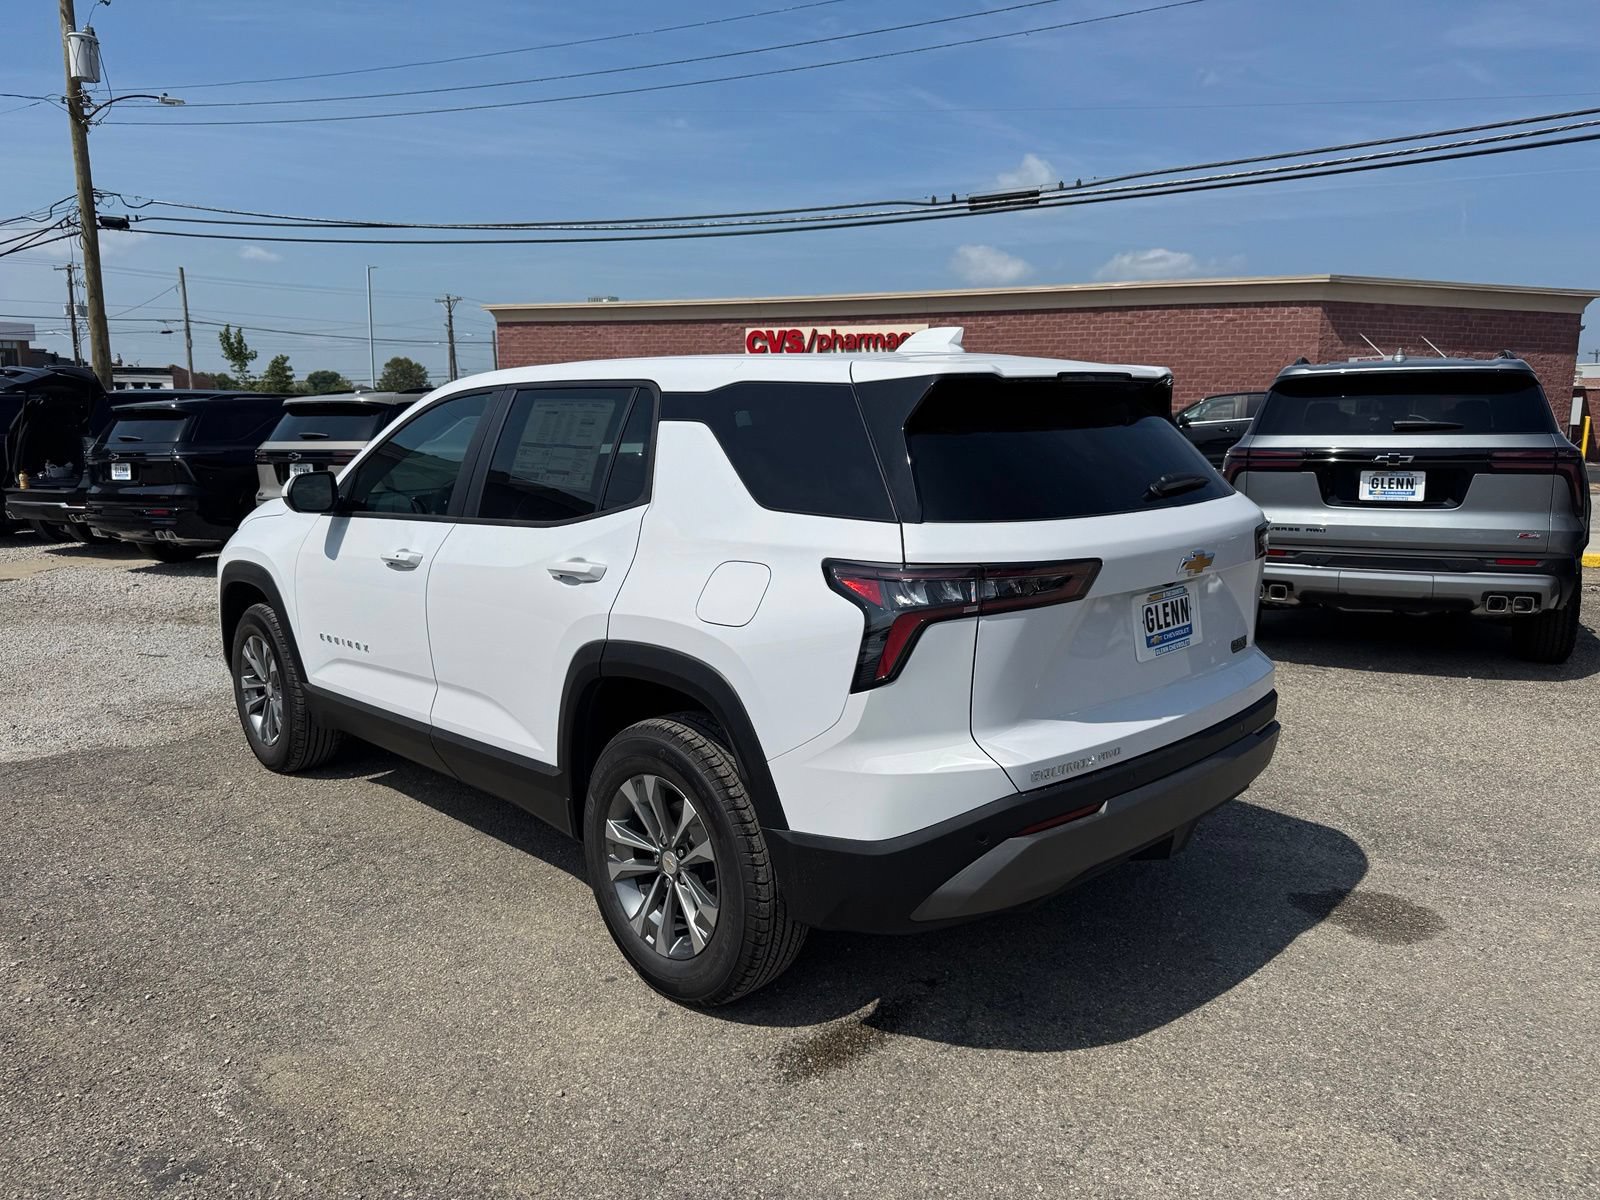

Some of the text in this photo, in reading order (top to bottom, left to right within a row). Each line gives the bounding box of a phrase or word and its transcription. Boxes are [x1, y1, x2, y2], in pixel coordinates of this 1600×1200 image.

[746, 328, 915, 353] CVS/pharmac
[1371, 477, 1415, 490] GLENN
[1145, 597, 1190, 633] GLENN
[320, 633, 370, 653] EQUINOX
[1163, 627, 1190, 641] CHEVROLET
[1031, 755, 1095, 782] EQUINOX
